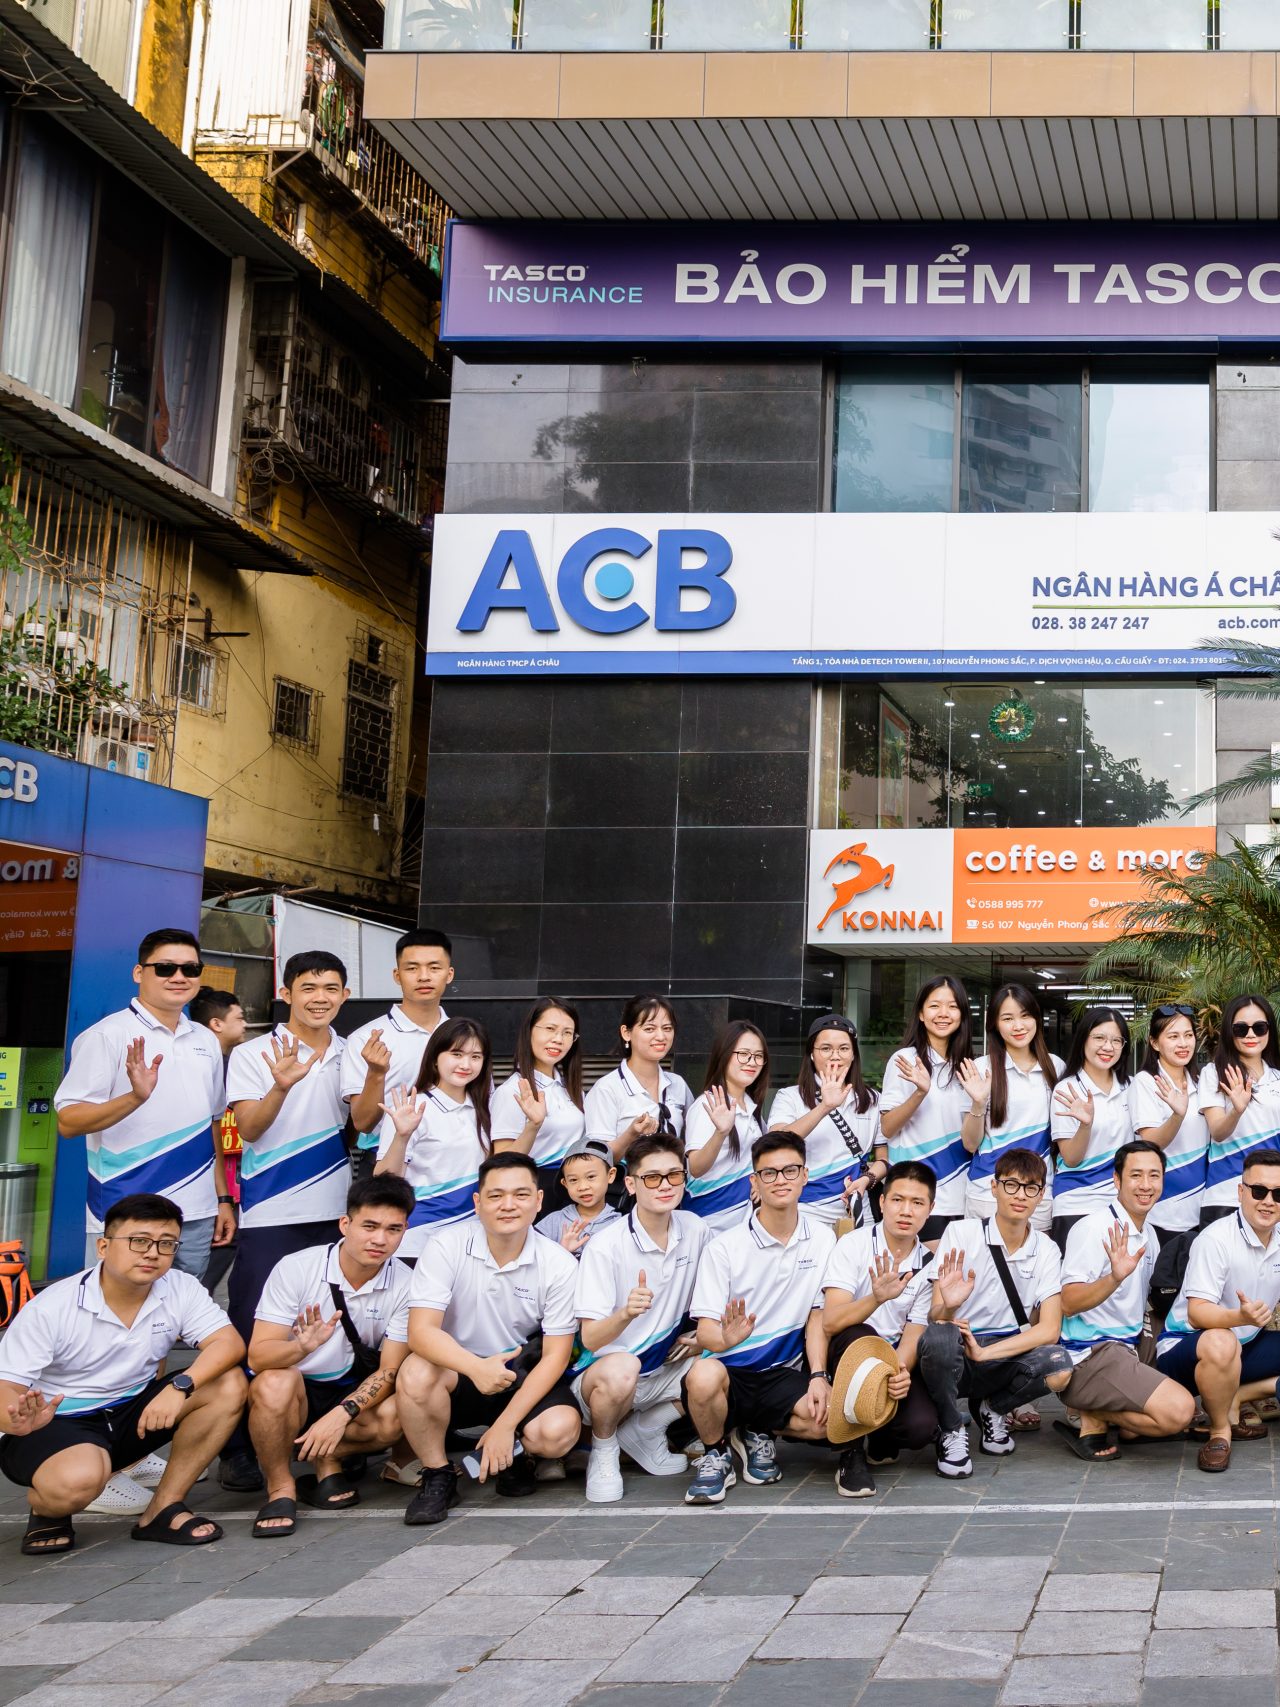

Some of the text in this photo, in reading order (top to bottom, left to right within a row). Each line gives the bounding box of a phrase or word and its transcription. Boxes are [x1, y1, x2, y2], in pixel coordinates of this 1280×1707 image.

[484, 265, 586, 282] TASCO
[675, 249, 827, 304] BẢO
[850, 243, 1031, 304] HIỂM
[488, 286, 643, 303] INSURANCE
[456, 527, 737, 633] ACB
[1032, 571, 1112, 598] NGÂN
[1119, 571, 1199, 598] HÀNG
[1204, 571, 1224, 597] Á
[1032, 616, 1150, 630] 028. 38 247 247
[457, 657, 560, 668] NGÂN HÀNG TMCP Á CHÂU
[824, 656, 841, 666] TÒA
[842, 656, 860, 665] NHÀ
[946, 655, 980, 665] NGUYỄN
[1039, 657, 1059, 666] DỊCH
[1060, 657, 1083, 667] VỌNG
[1173, 657, 1189, 665] 024.
[965, 844, 1204, 873] coffee & more
[978, 900, 1044, 909] 0588 995 777
[841, 910, 945, 932] KONNAI
[981, 919, 995, 929] Số
[998, 920, 1014, 929] 107
[1017, 918, 1054, 931] Nguyễn
[1057, 920, 1089, 931] Phong
[1092, 919, 1110, 929] Sắc
